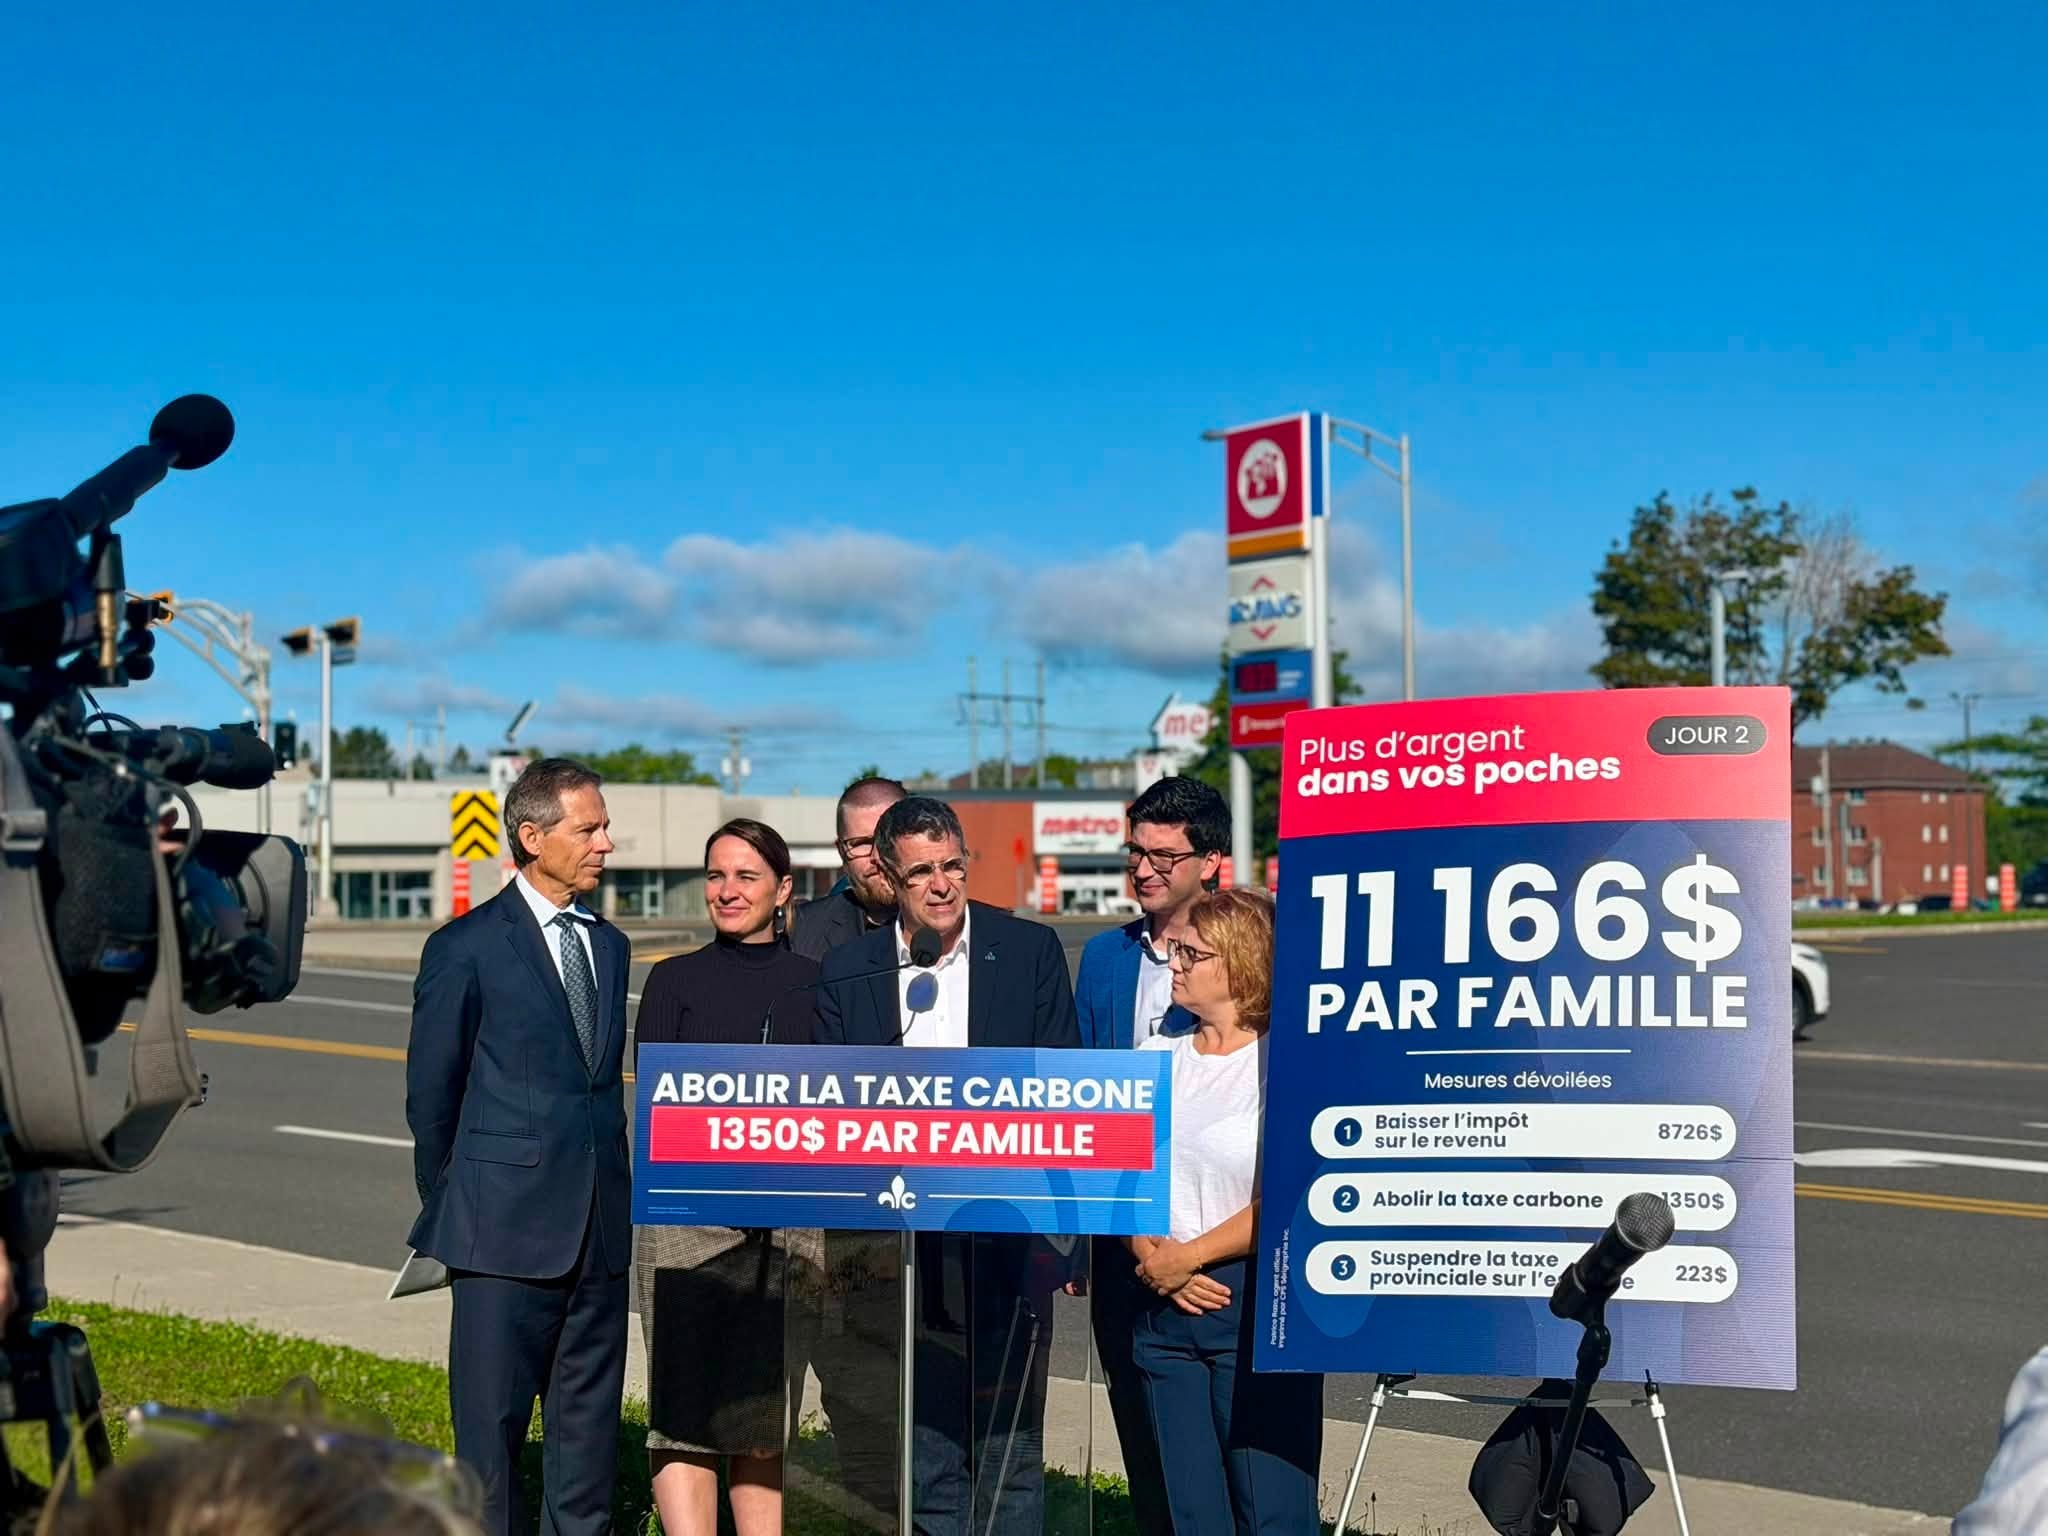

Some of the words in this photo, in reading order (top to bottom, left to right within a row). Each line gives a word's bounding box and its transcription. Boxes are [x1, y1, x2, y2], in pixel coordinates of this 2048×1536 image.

[1300, 737, 1365, 765] Plus
[1375, 724, 1525, 765] d’argent
[1664, 726, 1728, 745] JOUR
[1735, 725, 1750, 744] 2
[1297, 767, 1390, 797] dans
[1398, 760, 1465, 789] vos
[1473, 755, 1621, 795] poches
[1311, 870, 1395, 970] 11
[1432, 853, 1743, 972] 166$
[1307, 979, 1439, 1034] PAR
[1458, 975, 1748, 1030] FAMILLE
[1424, 1073, 1508, 1089] Mesures
[1513, 1070, 1612, 1089] dévoilées
[652, 1072, 790, 1104] ABOLIR
[799, 1074, 845, 1105] LA
[853, 1075, 953, 1107] TAXE
[962, 1076, 1154, 1110] CARBONE
[1343, 1124, 1352, 1140] 1
[1375, 1112, 1450, 1130] Baisser
[1454, 1111, 1529, 1133] l’impôt
[1658, 1123, 1723, 1142] 8726$
[707, 1116, 826, 1155] 1350$
[837, 1120, 919, 1153] PAR
[929, 1121, 1095, 1157] FAMILLE
[1375, 1135, 1408, 1149] sur
[1411, 1132, 1429, 1148] le
[1433, 1134, 1506, 1149] revenu
[1341, 1191, 1352, 1207] 2
[1372, 1189, 1434, 1207] Abolir
[1438, 1190, 1457, 1207] la
[1461, 1191, 1508, 1207] taxe
[1512, 1190, 1604, 1209] carbone
[1338, 1260, 1349, 1276] 3
[1371, 1249, 1482, 1271] Suspendre
[1486, 1249, 1506, 1267] la
[1510, 1251, 1559, 1268] taxe
[1370, 1267, 1487, 1291] provinciale
[1492, 1272, 1527, 1287] sur
[1675, 1264, 1728, 1285] 223$
